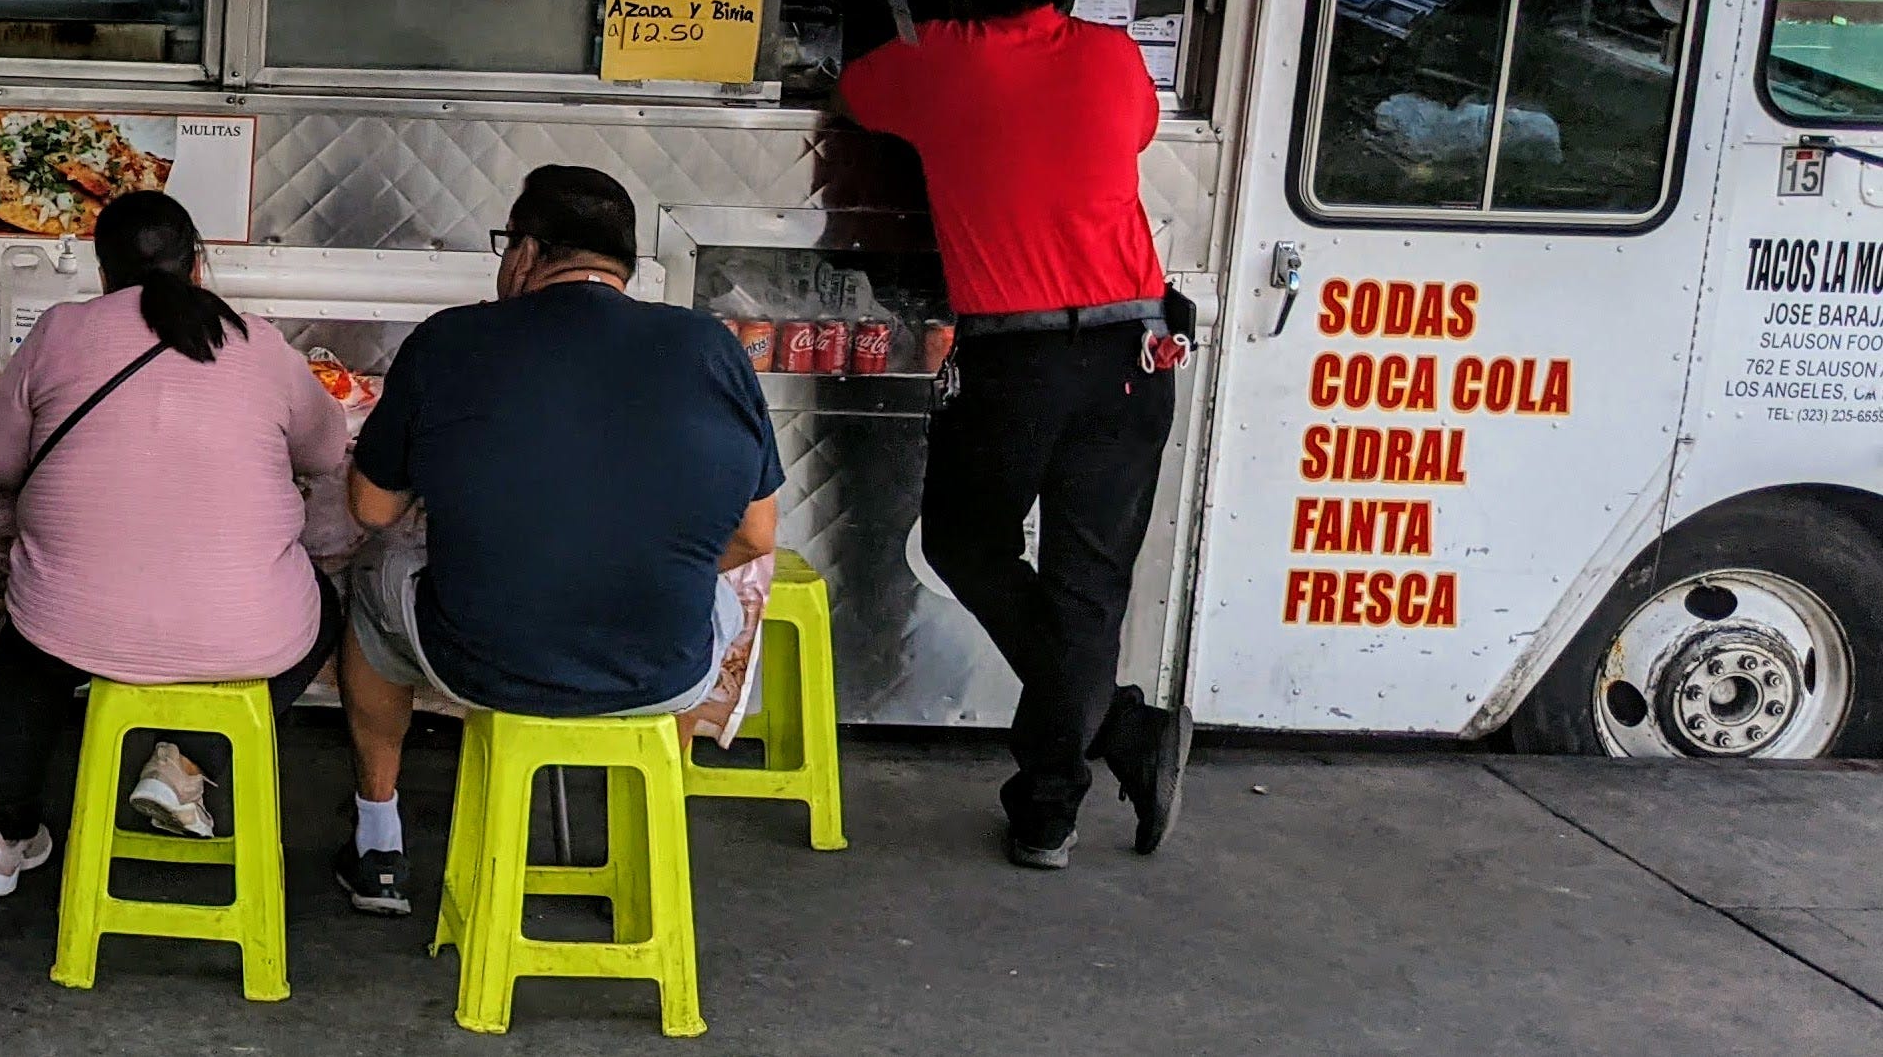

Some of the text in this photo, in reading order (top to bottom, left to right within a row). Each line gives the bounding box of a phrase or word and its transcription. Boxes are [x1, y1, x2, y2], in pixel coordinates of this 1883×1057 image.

[181, 124, 241, 138] MULITAS
[1786, 160, 1820, 192] 15
[1745, 238, 1819, 292] TACOS
[1820, 241, 1849, 293] LA
[1318, 277, 1479, 340] SODAS
[1764, 303, 1883, 327] JOSE BARAJ
[1760, 332, 1841, 350] SLAUSON
[1308, 351, 1572, 416] COCA COLA
[1746, 359, 1774, 375] 762
[1779, 360, 1790, 375] E
[1796, 360, 1877, 378] SLAUSON
[1725, 381, 1759, 397] LOS
[1762, 382, 1847, 401] ANGELES,
[1797, 408, 1828, 425] (323)
[1299, 424, 1468, 485] SIDRAL
[1290, 496, 1432, 556] FANTA
[1282, 568, 1458, 628] FRESCA
